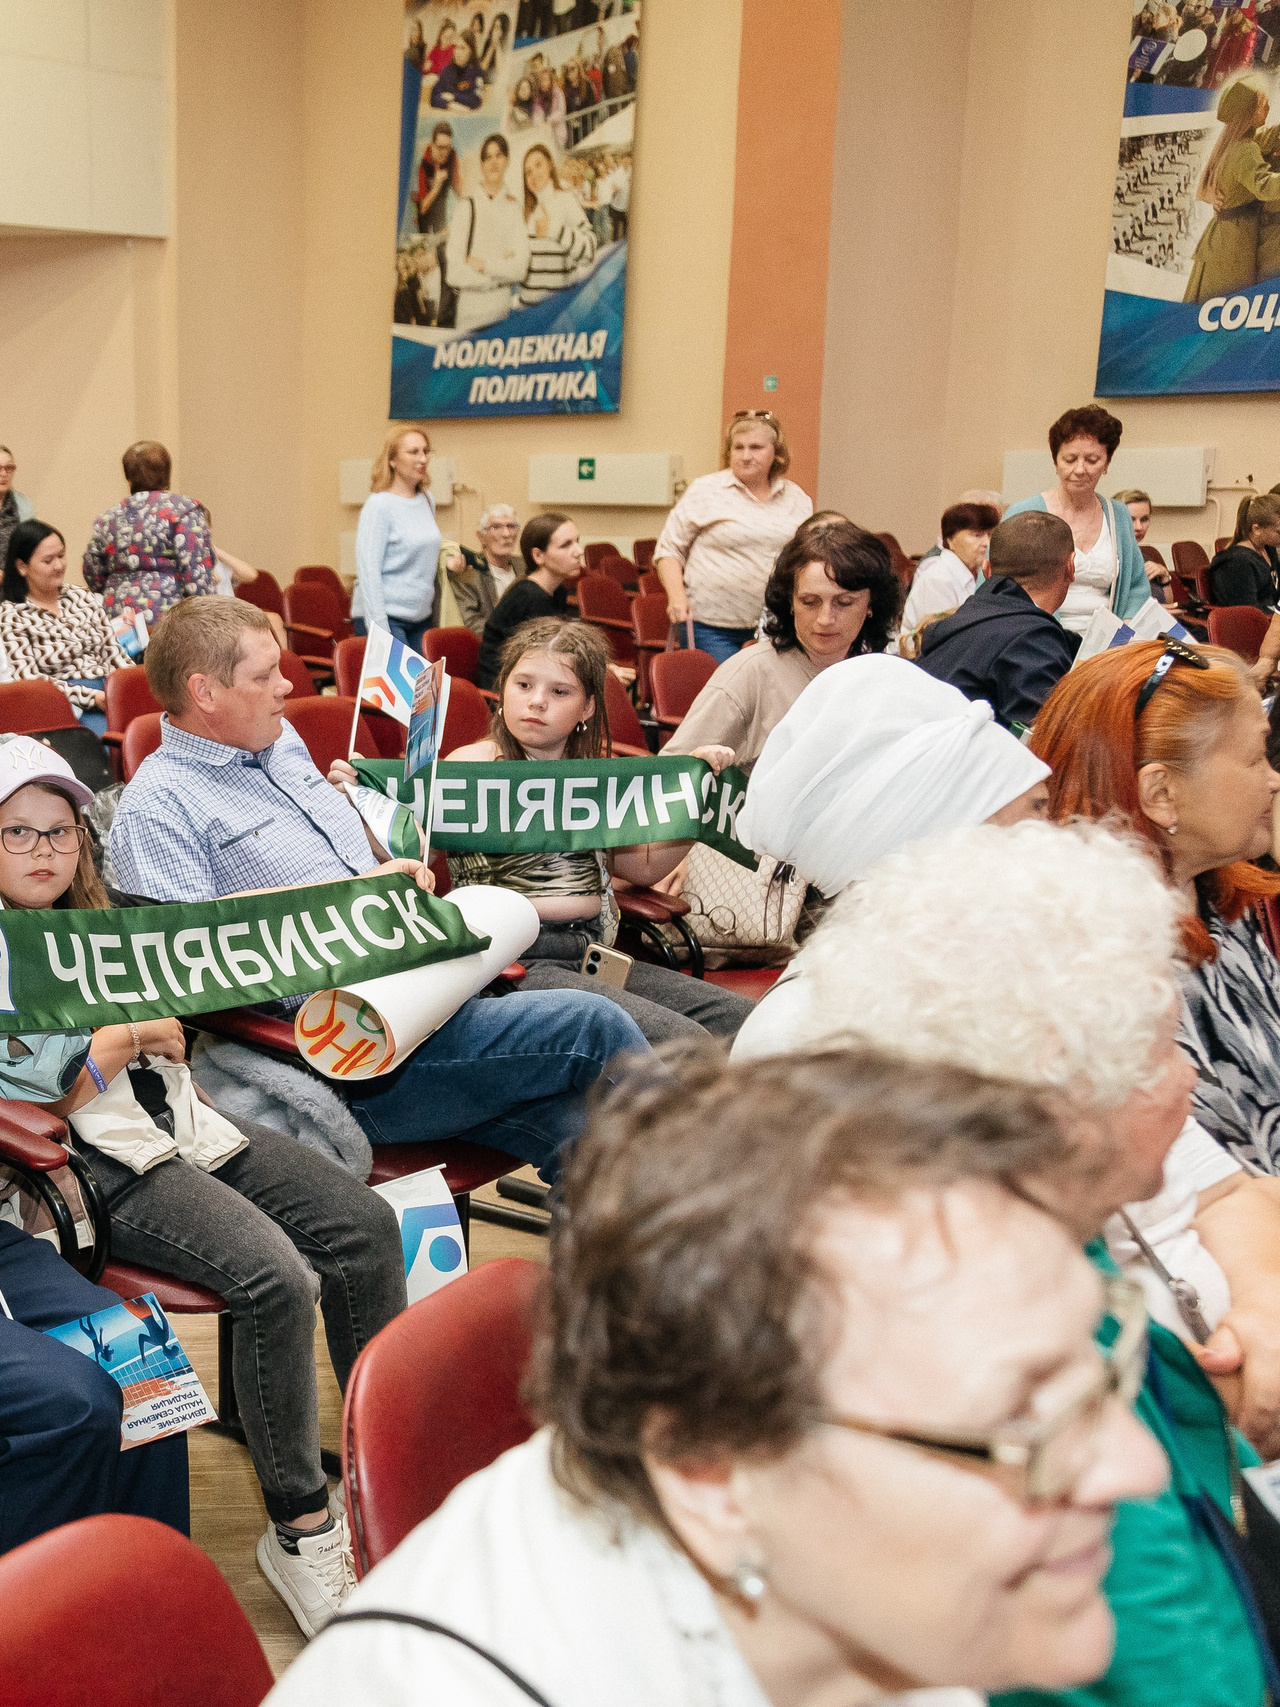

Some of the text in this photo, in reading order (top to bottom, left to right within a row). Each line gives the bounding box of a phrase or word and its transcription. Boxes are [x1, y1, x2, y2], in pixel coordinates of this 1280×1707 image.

[1198, 293, 1280, 332] СОЦ
[432, 330, 608, 369] МОЛОДЕЖНАЯ
[469, 370, 597, 405] ПОЛИТИКА
[43, 888, 448, 1004] ЧЕЛЯБИНСК
[126, 1399, 204, 1430] НАША СЕМЕЙНАЯ
[150, 1390, 199, 1411] ТРАДИЦИЯ
[157, 1407, 207, 1430] ДВИЖЕНИЕ
